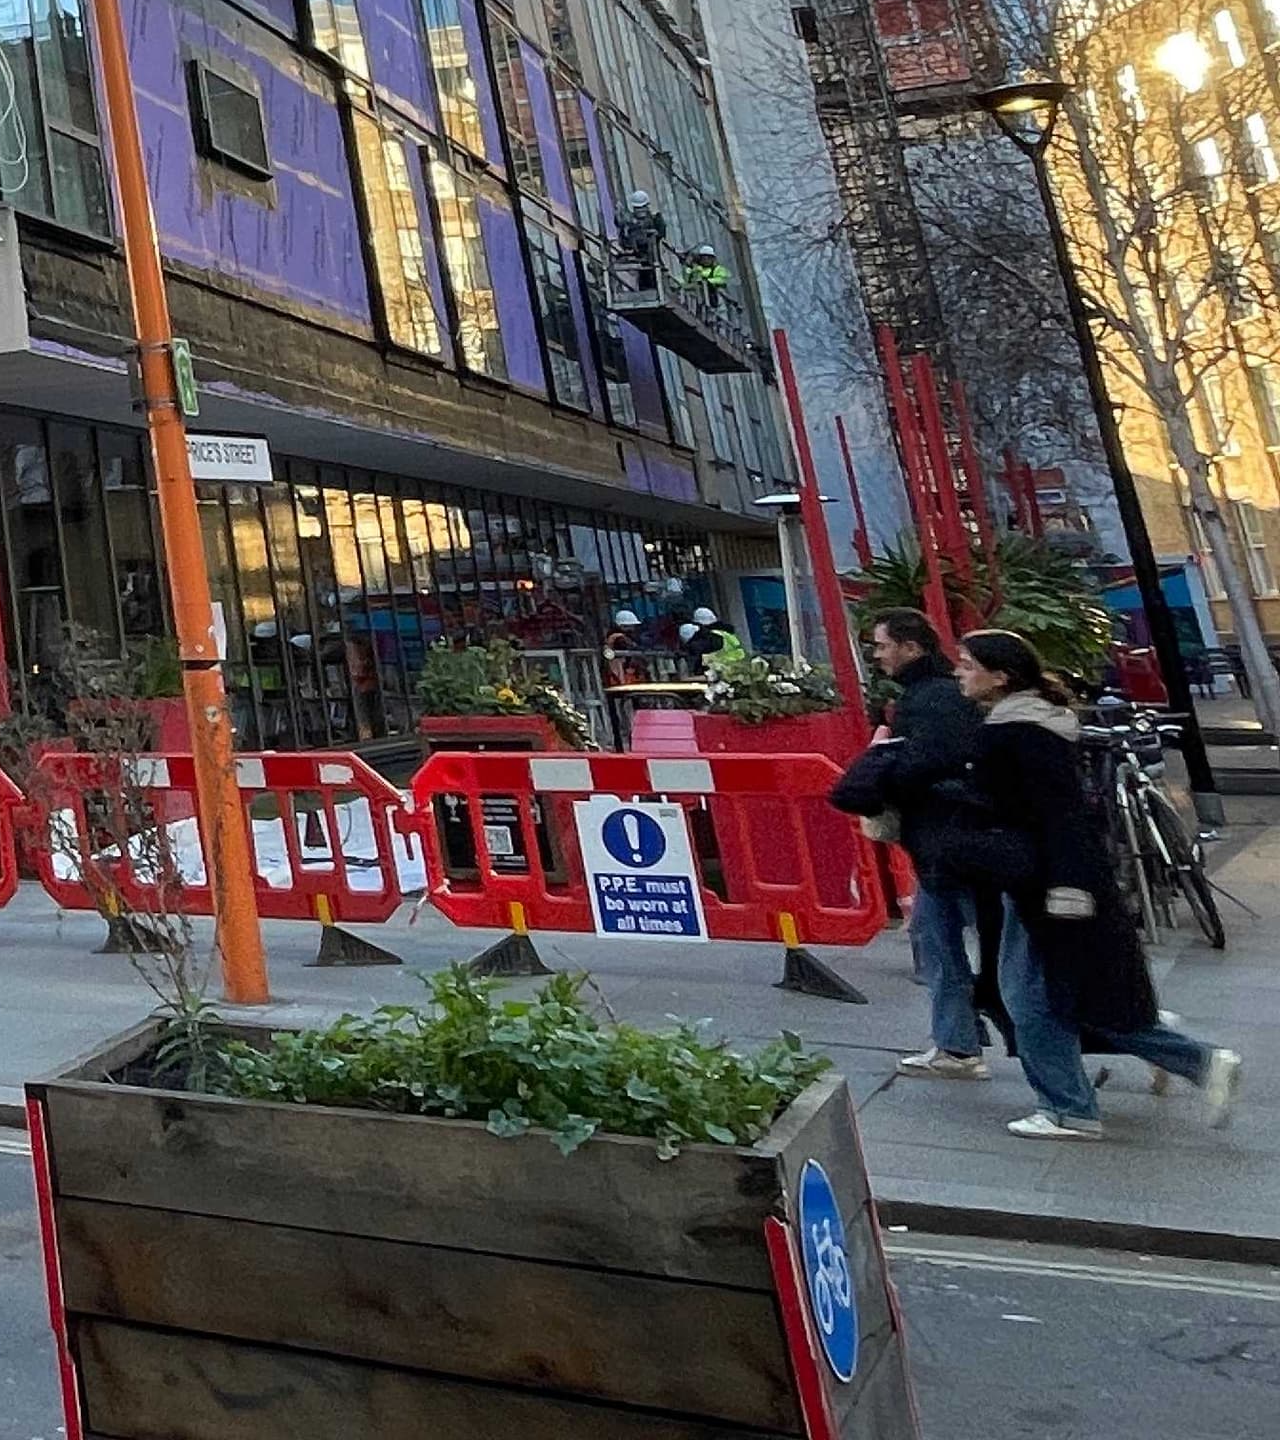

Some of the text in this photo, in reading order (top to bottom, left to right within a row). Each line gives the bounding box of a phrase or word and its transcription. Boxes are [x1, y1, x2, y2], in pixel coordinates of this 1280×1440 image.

[645, 880, 687, 895] must
[604, 895, 689, 914] be worn at
[617, 914, 684, 933] all times
